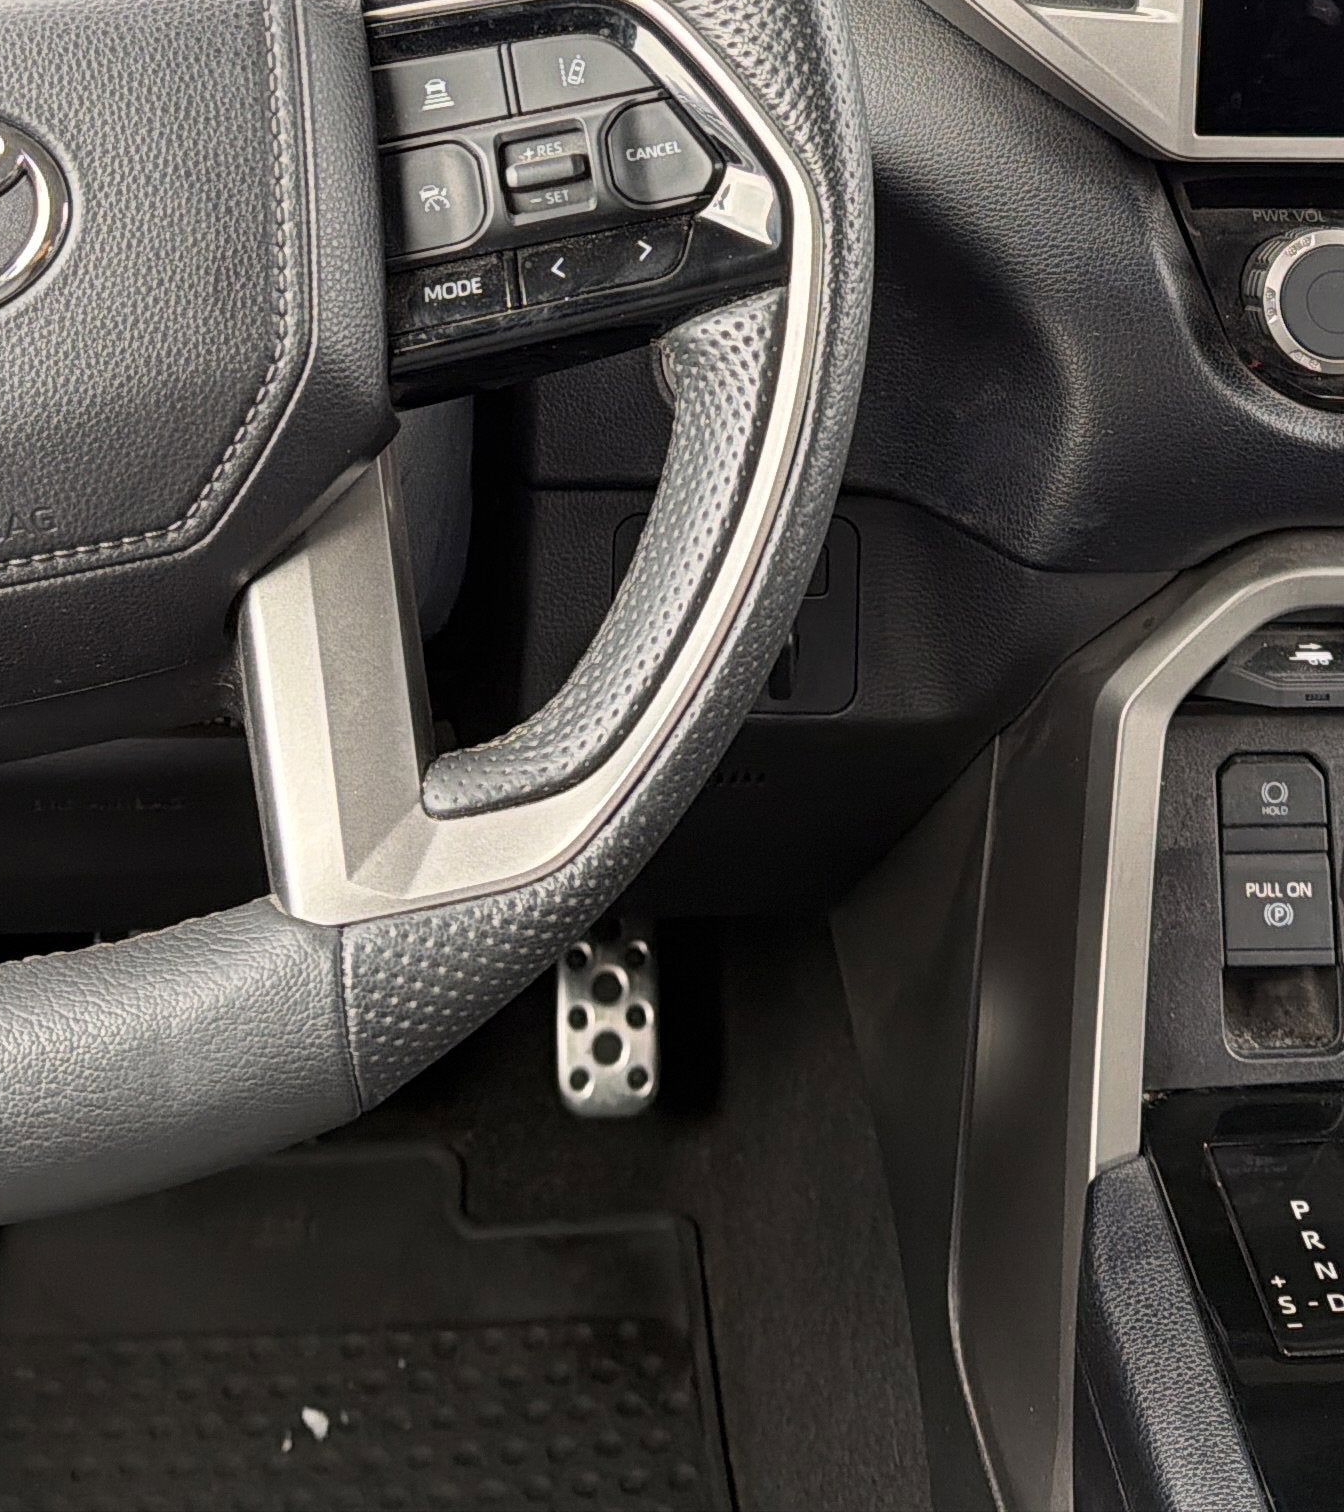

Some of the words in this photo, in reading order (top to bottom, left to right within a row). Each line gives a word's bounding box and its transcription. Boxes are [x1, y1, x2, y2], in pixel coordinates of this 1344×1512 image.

[536, 140, 563, 158] RES
[625, 140, 683, 163] CANCEL
[545, 189, 569, 205] SET
[1252, 208, 1290, 222] PWR
[1293, 208, 1327, 223] VOL
[423, 277, 484, 304] MODE
[1261, 806, 1289, 816] HOLD
[1245, 882, 1284, 898] PULL
[1286, 882, 1313, 898] ON
[1289, 1199, 1310, 1220] P
[1300, 1230, 1326, 1250] R
[1313, 1261, 1339, 1280] N
[1277, 1295, 1298, 1315] S
